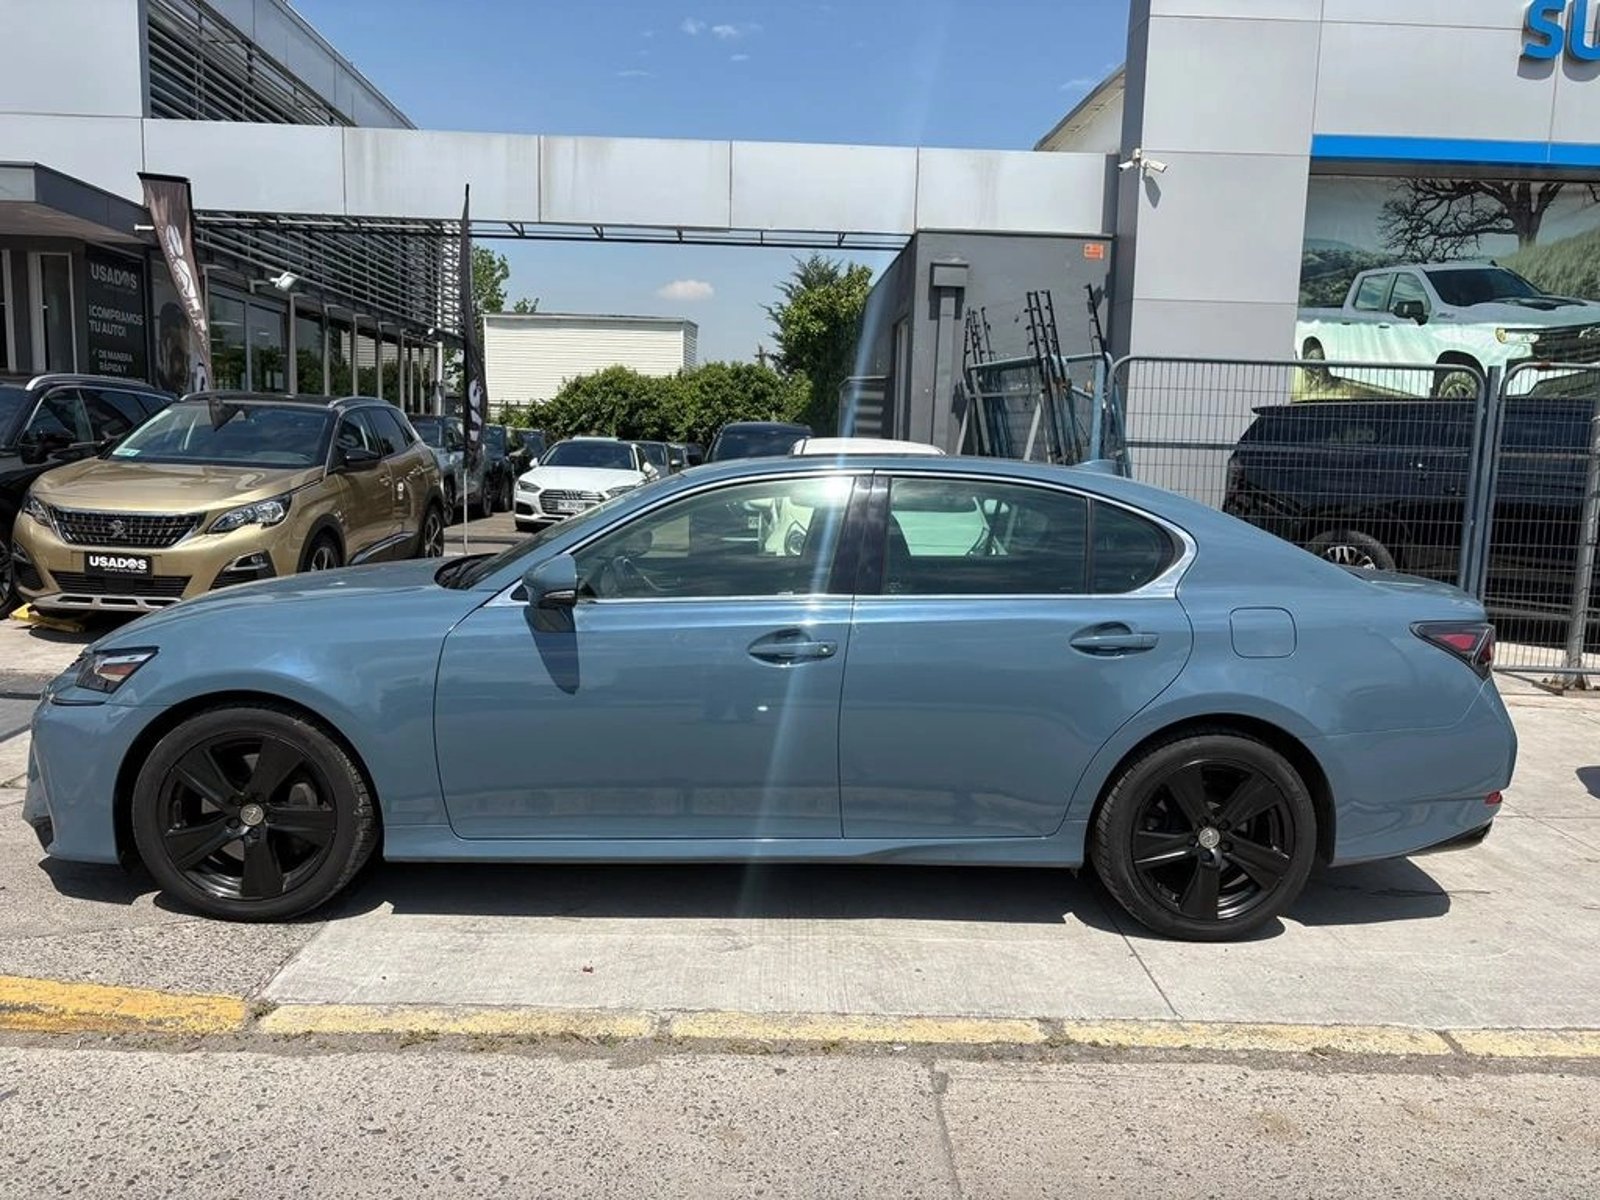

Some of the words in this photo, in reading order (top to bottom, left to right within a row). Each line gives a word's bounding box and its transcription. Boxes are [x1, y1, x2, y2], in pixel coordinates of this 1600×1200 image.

[90, 262, 137, 289] USADOS
[88, 319, 101, 333] TU
[89, 556, 147, 570] USADOS
